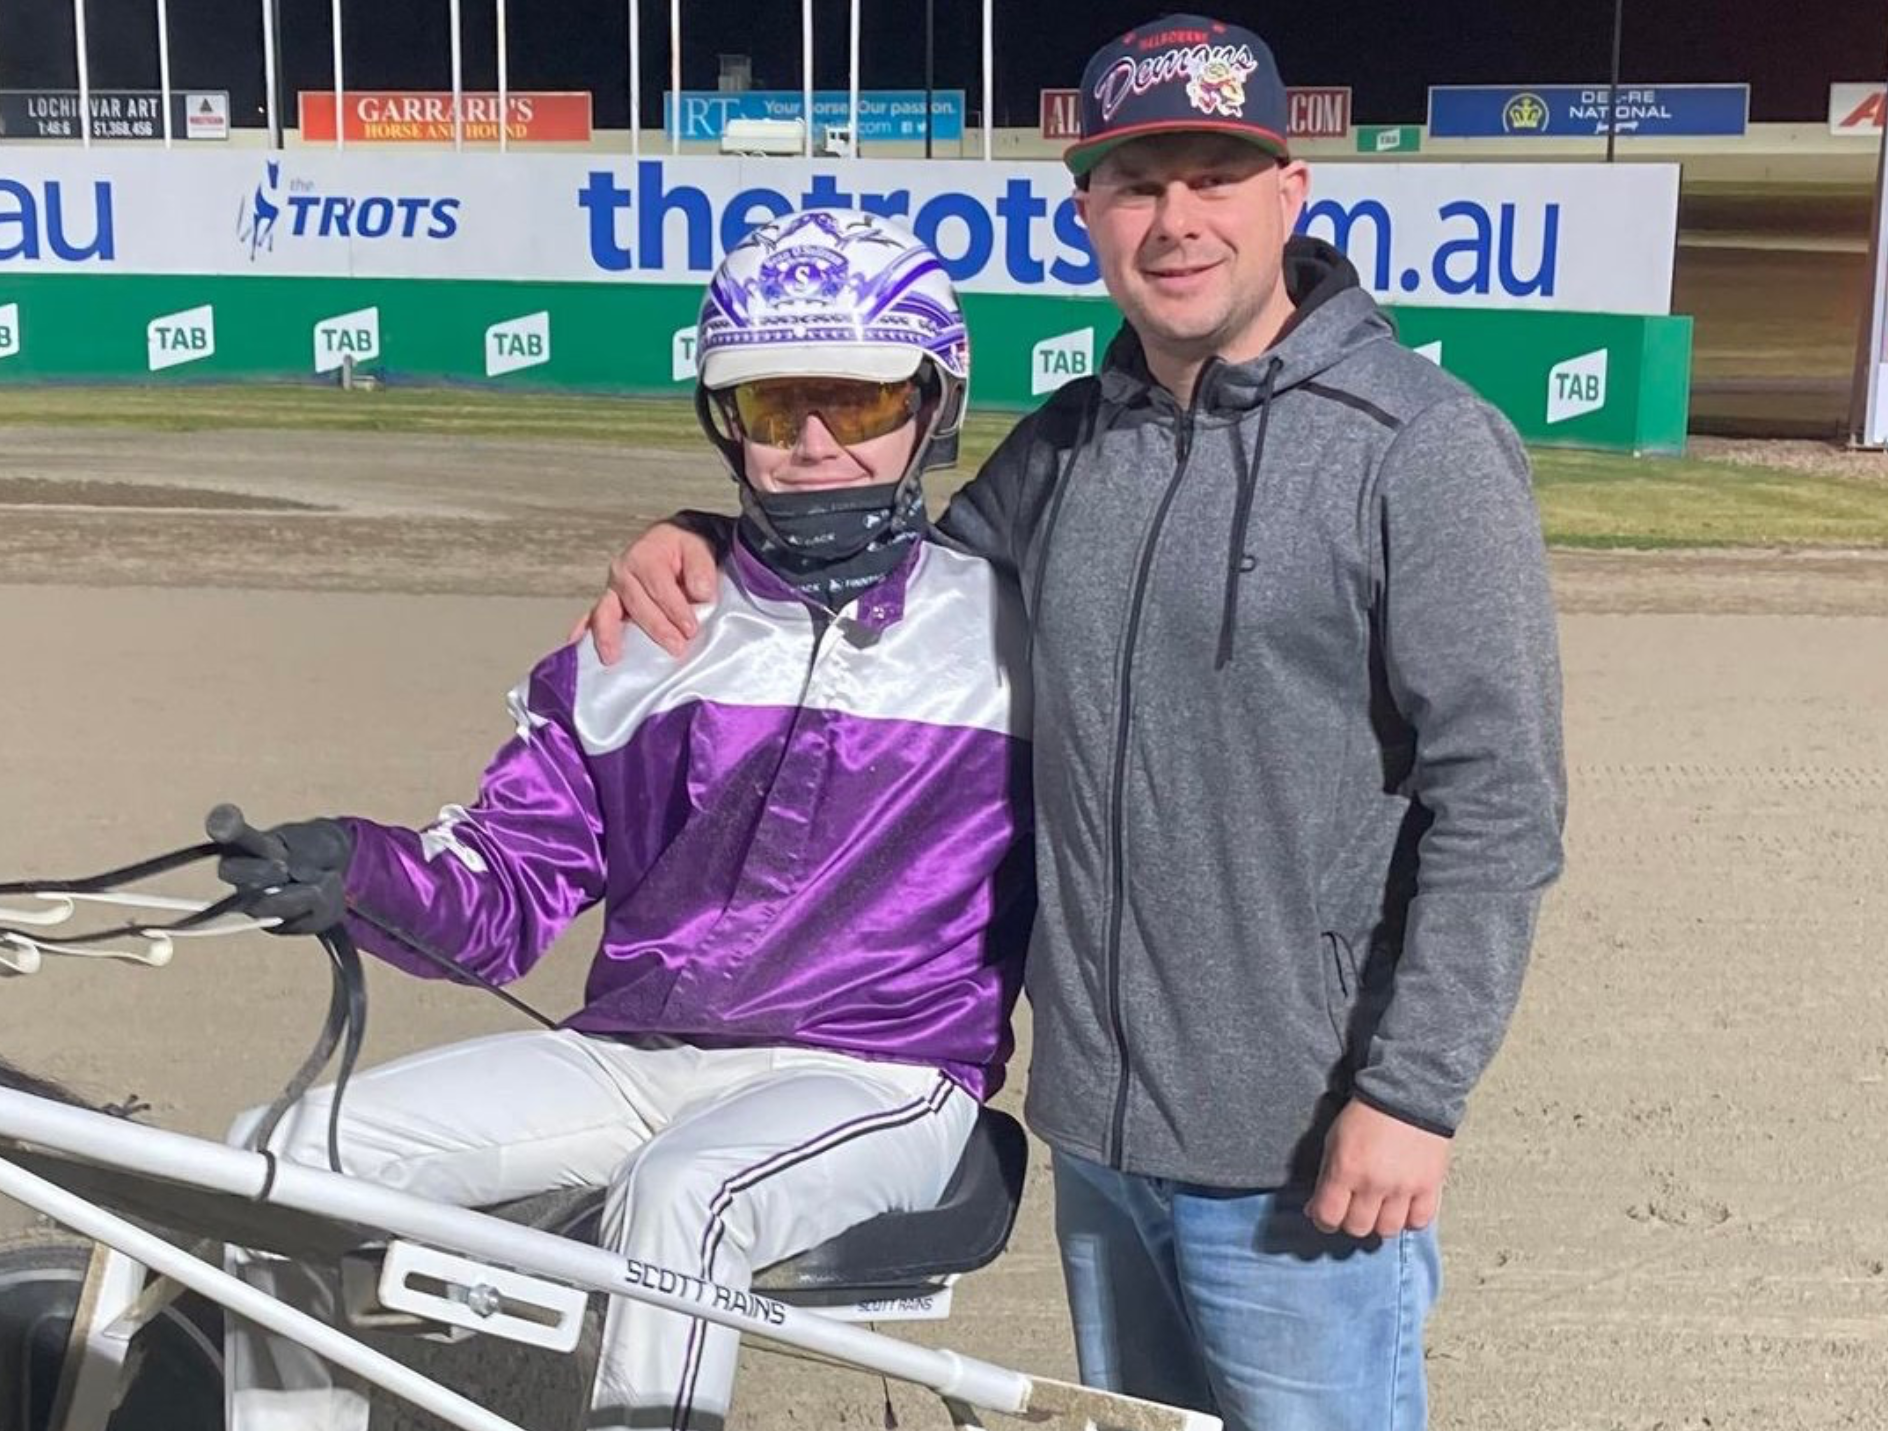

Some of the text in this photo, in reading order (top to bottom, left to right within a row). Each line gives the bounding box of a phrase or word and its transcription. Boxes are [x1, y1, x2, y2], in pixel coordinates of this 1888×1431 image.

[1094, 43, 1257, 121] Demons
[27, 97, 158, 118] LOCHIVAR ART
[1581, 90, 1654, 104] DE-RE
[764, 100, 799, 114] Your
[858, 100, 887, 114] Our
[890, 101, 957, 117] passon.
[1569, 105, 1671, 119] NATONAL
[365, 123, 421, 139] HORSE
[289, 178, 315, 192] the
[288, 196, 460, 239] TROTS
[154, 327, 207, 350] TAB
[321, 329, 372, 351] TAB
[493, 333, 542, 356] TAB
[1040, 350, 1086, 374] TAB
[1556, 373, 1599, 401] TAB
[625, 1260, 786, 1325] SCOTT RAINS
[858, 1298, 933, 1312] SCOTT RAINS
